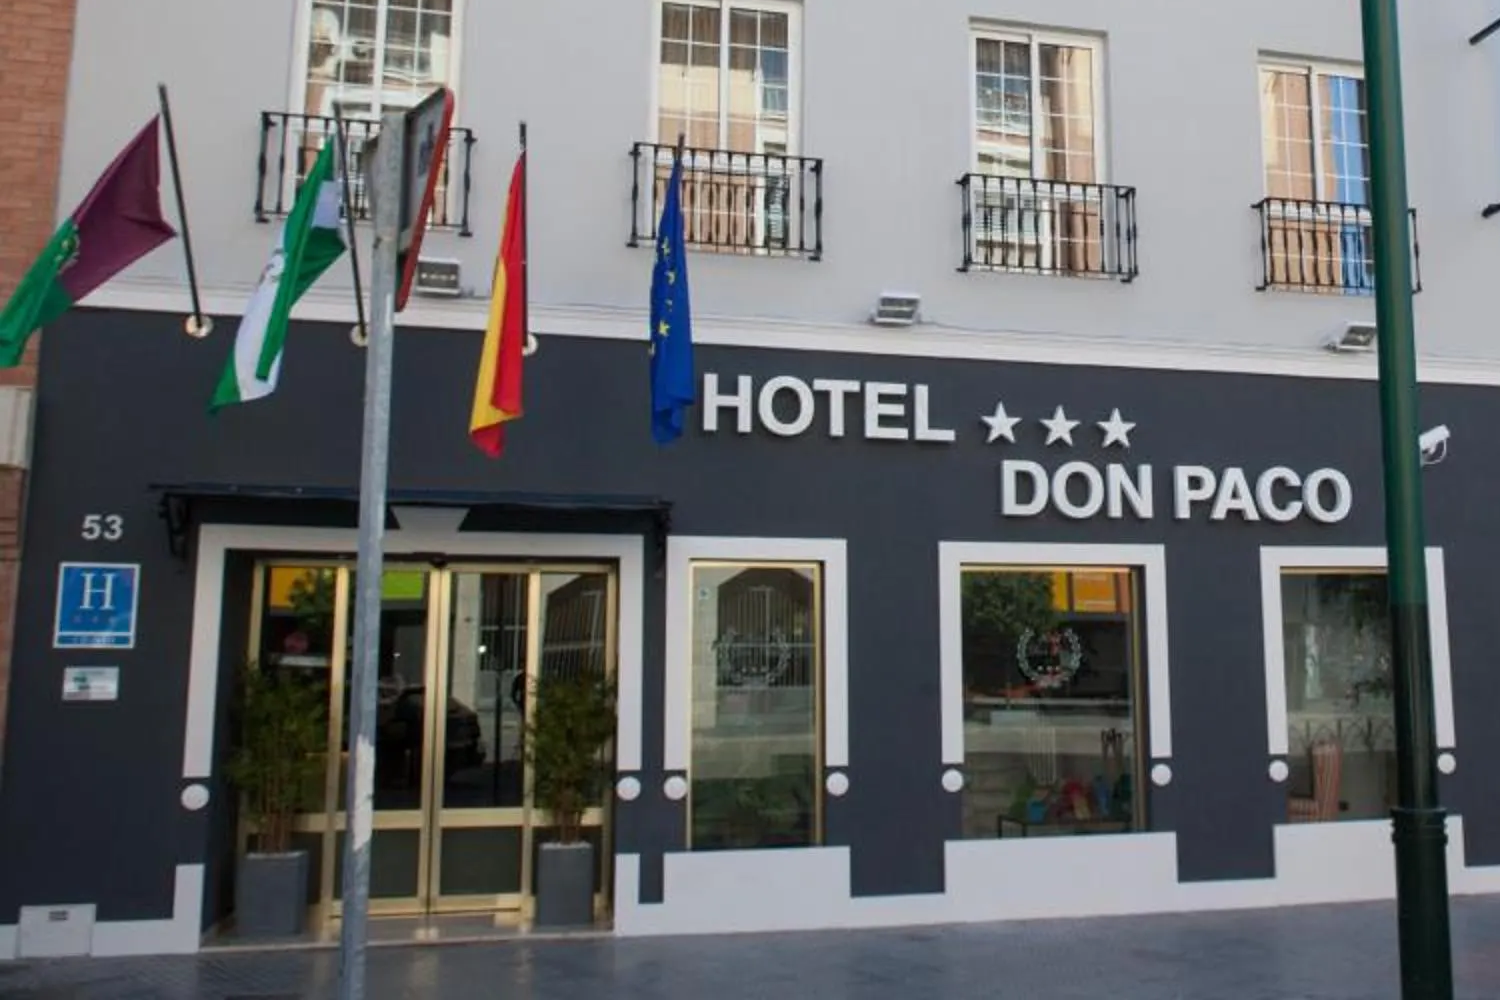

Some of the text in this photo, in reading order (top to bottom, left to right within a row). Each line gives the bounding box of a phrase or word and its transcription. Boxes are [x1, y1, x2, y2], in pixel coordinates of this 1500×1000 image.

[702, 373, 955, 443] HOTEL
[1001, 459, 1353, 523] DON PACO
[81, 513, 124, 540] 53
[79, 571, 119, 611] H
